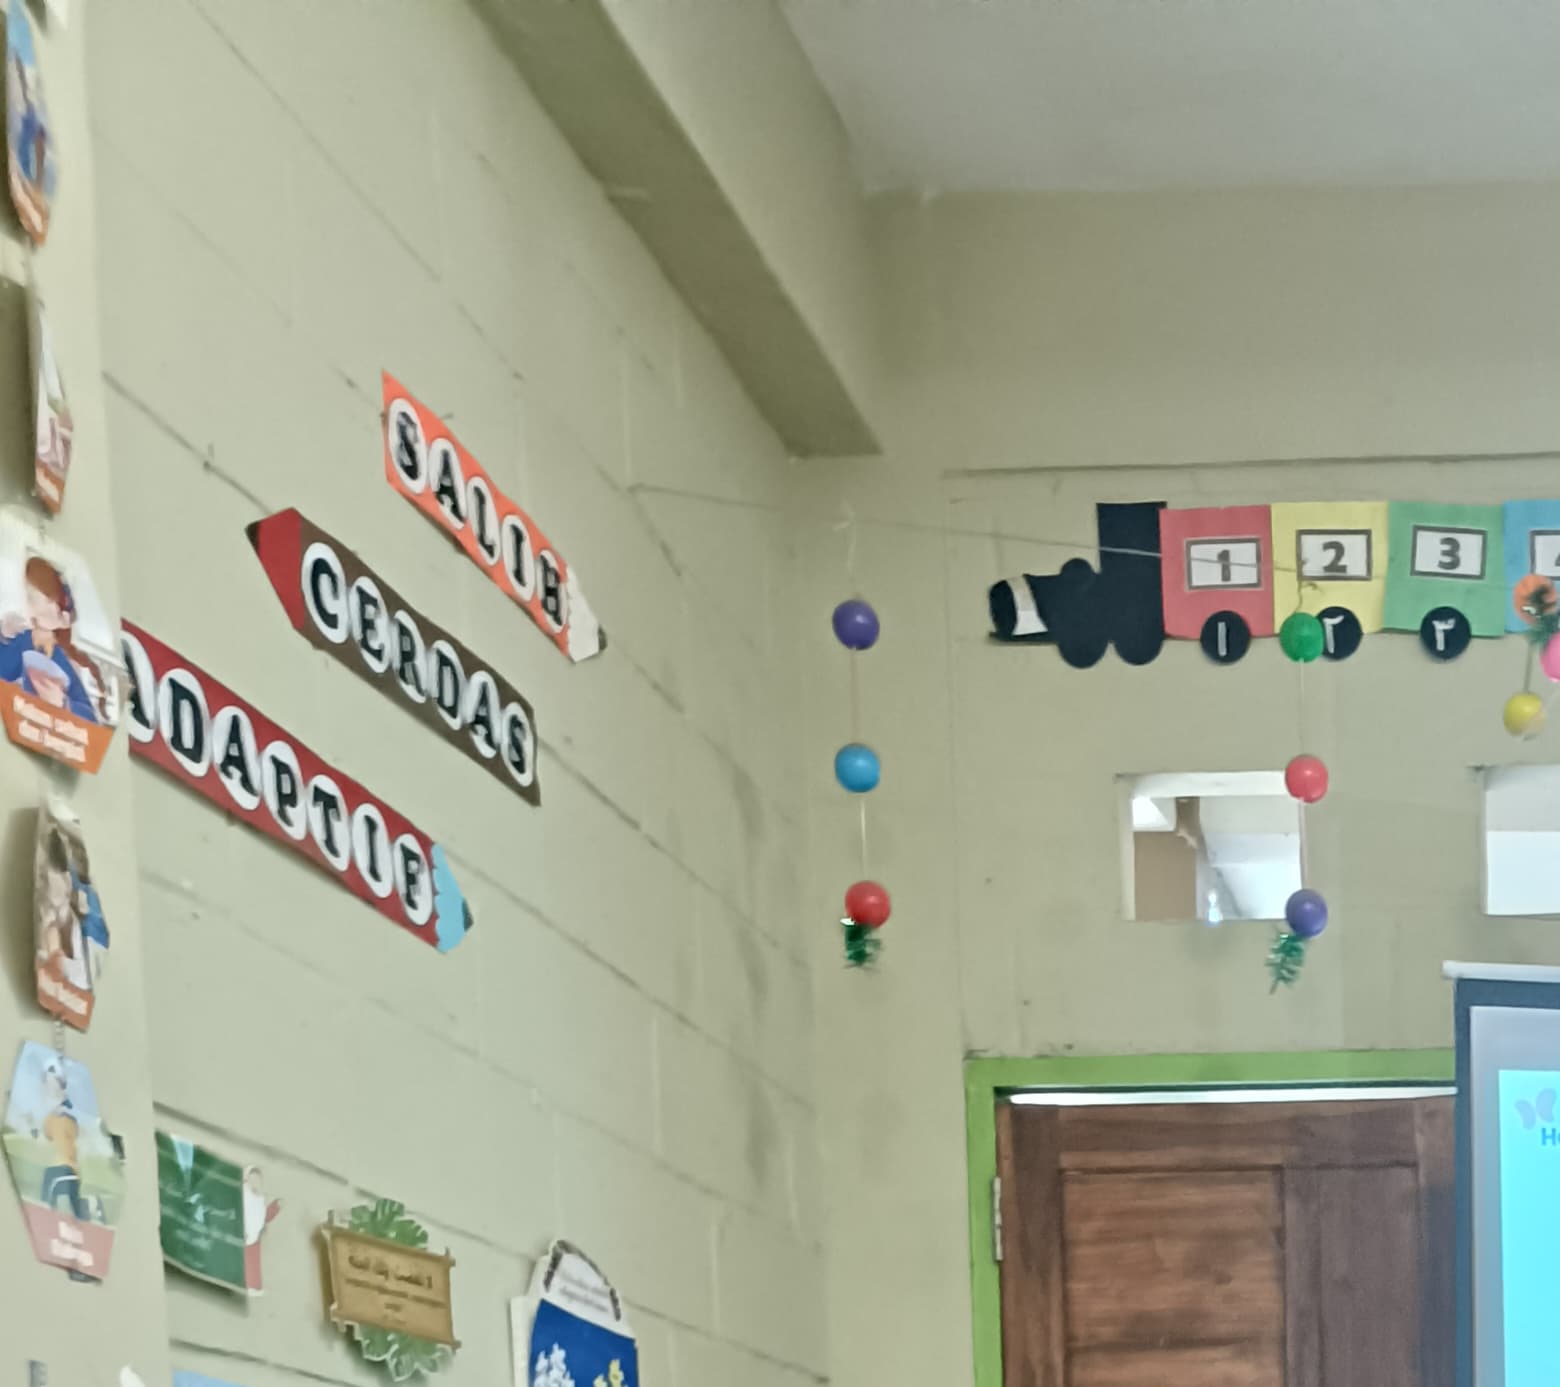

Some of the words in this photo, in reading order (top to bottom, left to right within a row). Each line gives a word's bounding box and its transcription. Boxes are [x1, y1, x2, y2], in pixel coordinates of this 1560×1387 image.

[395, 410, 564, 628] SALIH
[1218, 549, 1231, 582] 1
[1322, 541, 1347, 573] 2
[1438, 537, 1461, 570] 3
[310, 555, 533, 779] CERDAS
